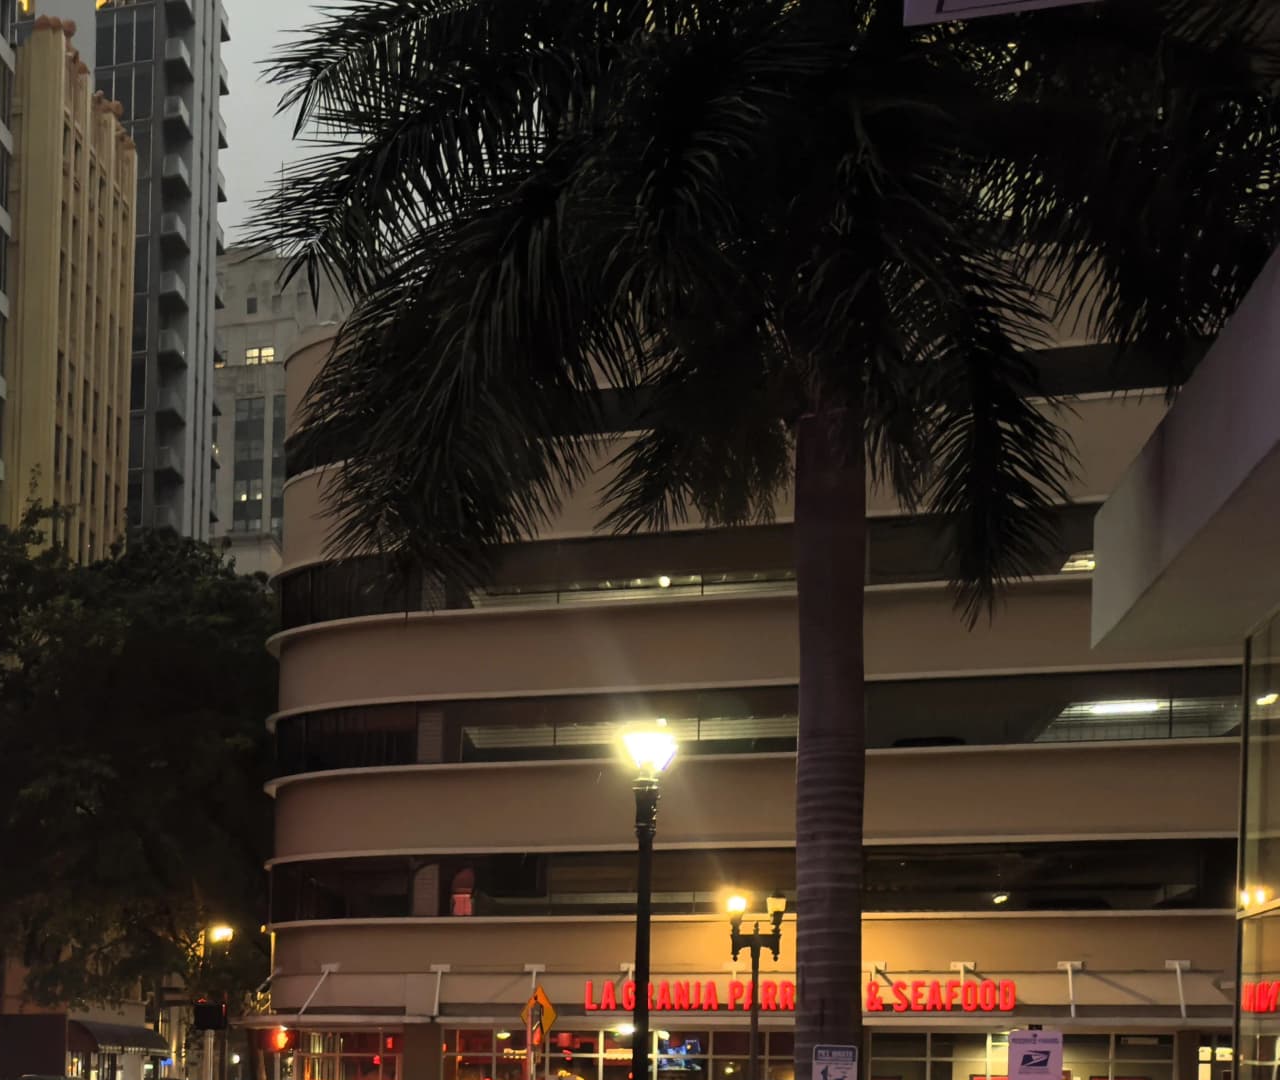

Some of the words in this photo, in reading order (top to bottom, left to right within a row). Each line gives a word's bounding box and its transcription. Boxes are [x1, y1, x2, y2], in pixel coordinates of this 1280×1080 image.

[584, 980, 617, 1011] LA
[865, 980, 884, 1012] &
[892, 979, 1017, 1013] SEAFOOD
